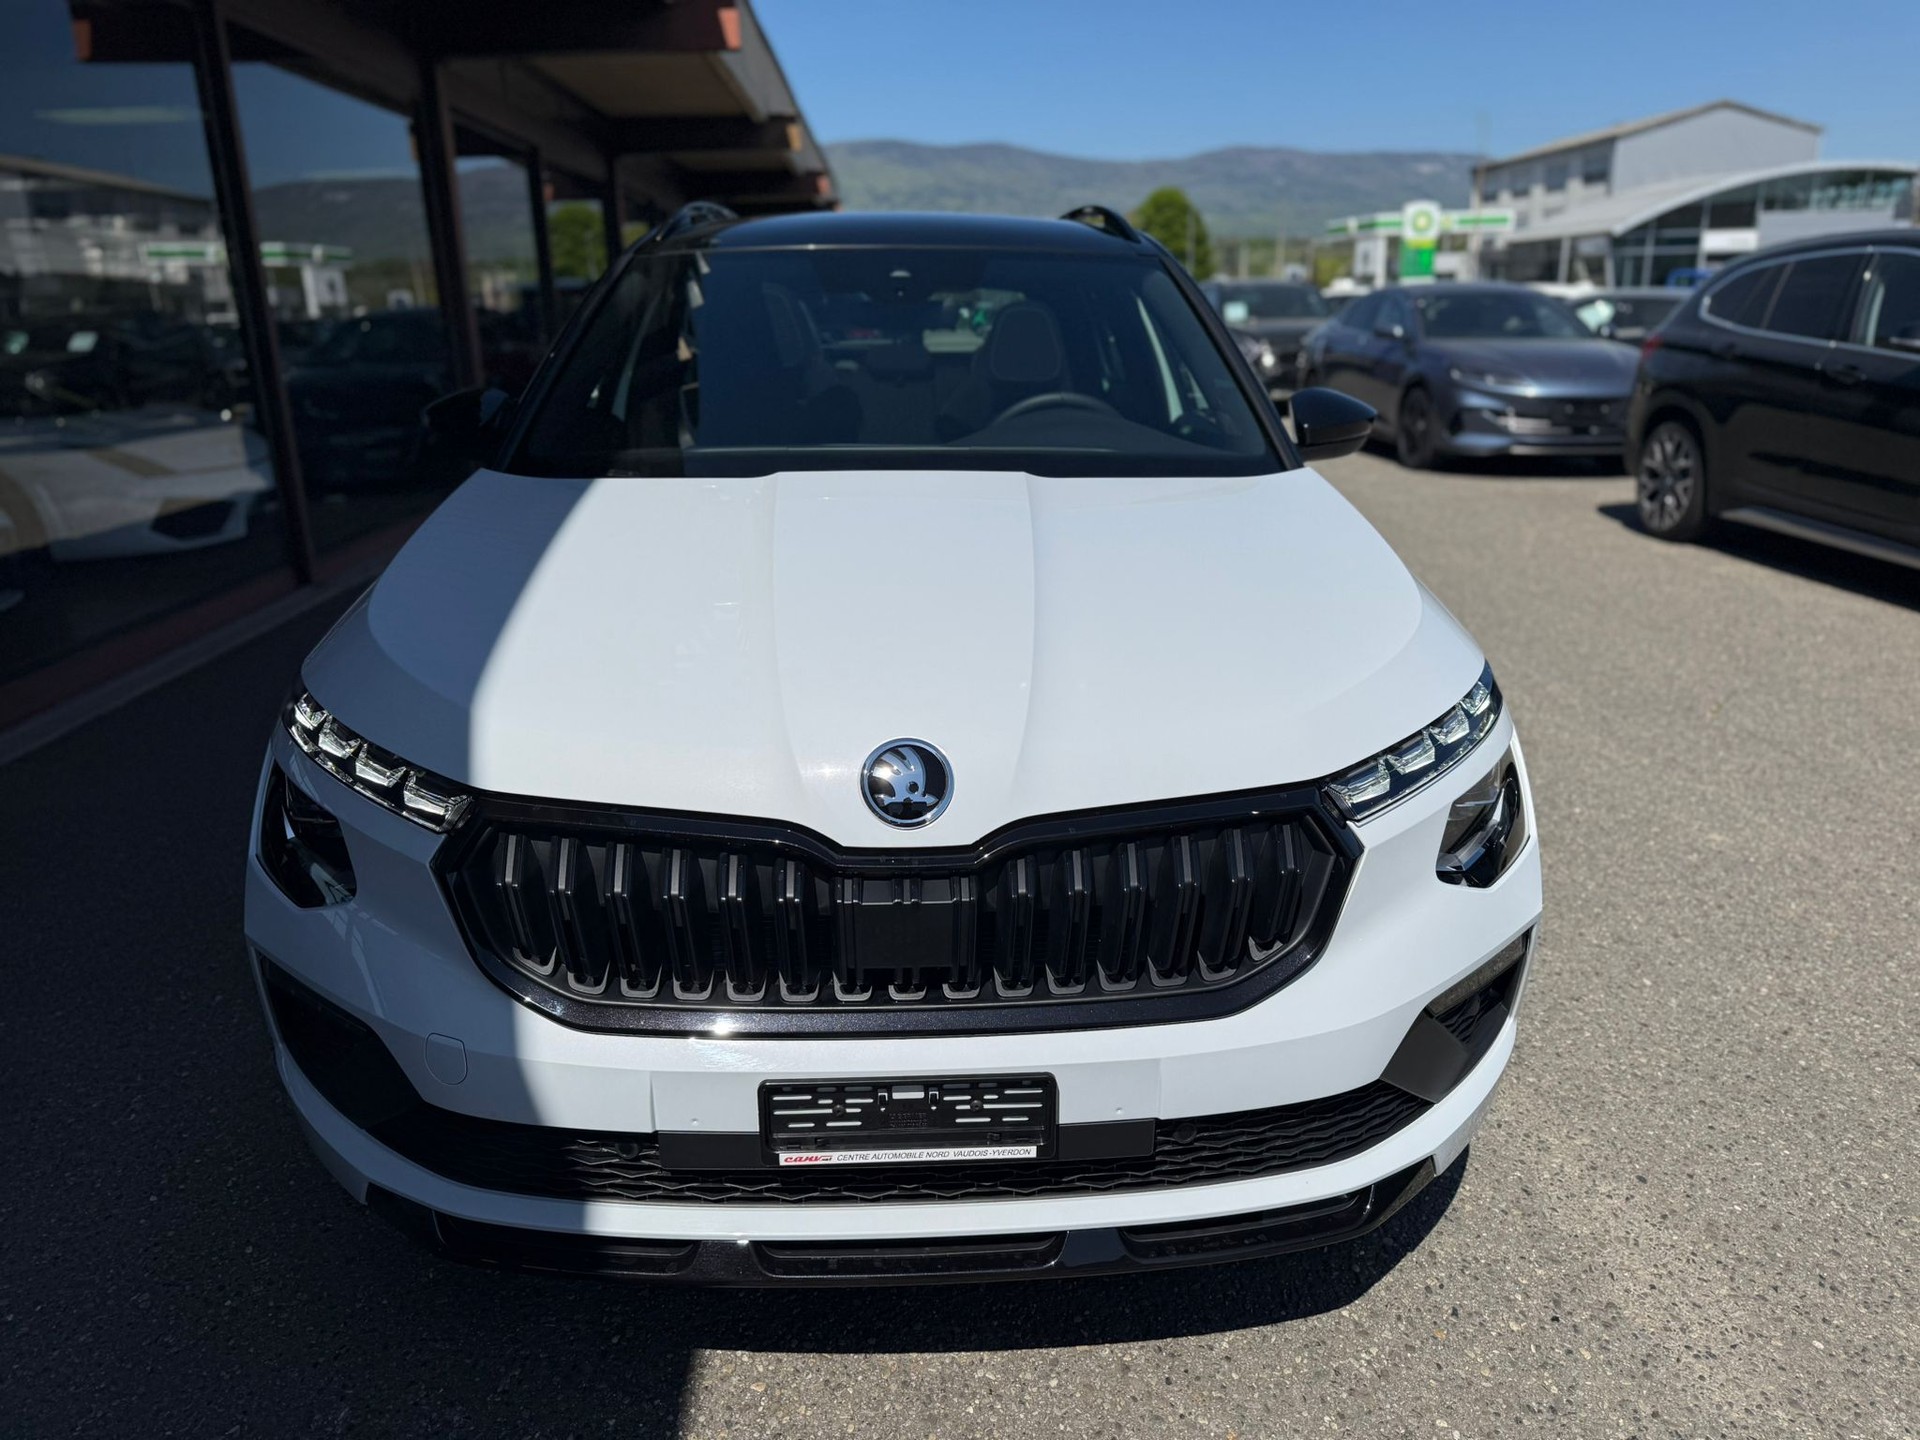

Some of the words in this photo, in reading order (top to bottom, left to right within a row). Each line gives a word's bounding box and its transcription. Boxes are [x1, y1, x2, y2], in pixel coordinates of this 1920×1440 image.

[836, 1153, 869, 1162] CENTRE
[871, 1151, 924, 1161] AUTOMOBILE
[925, 1150, 950, 1158] NORD
